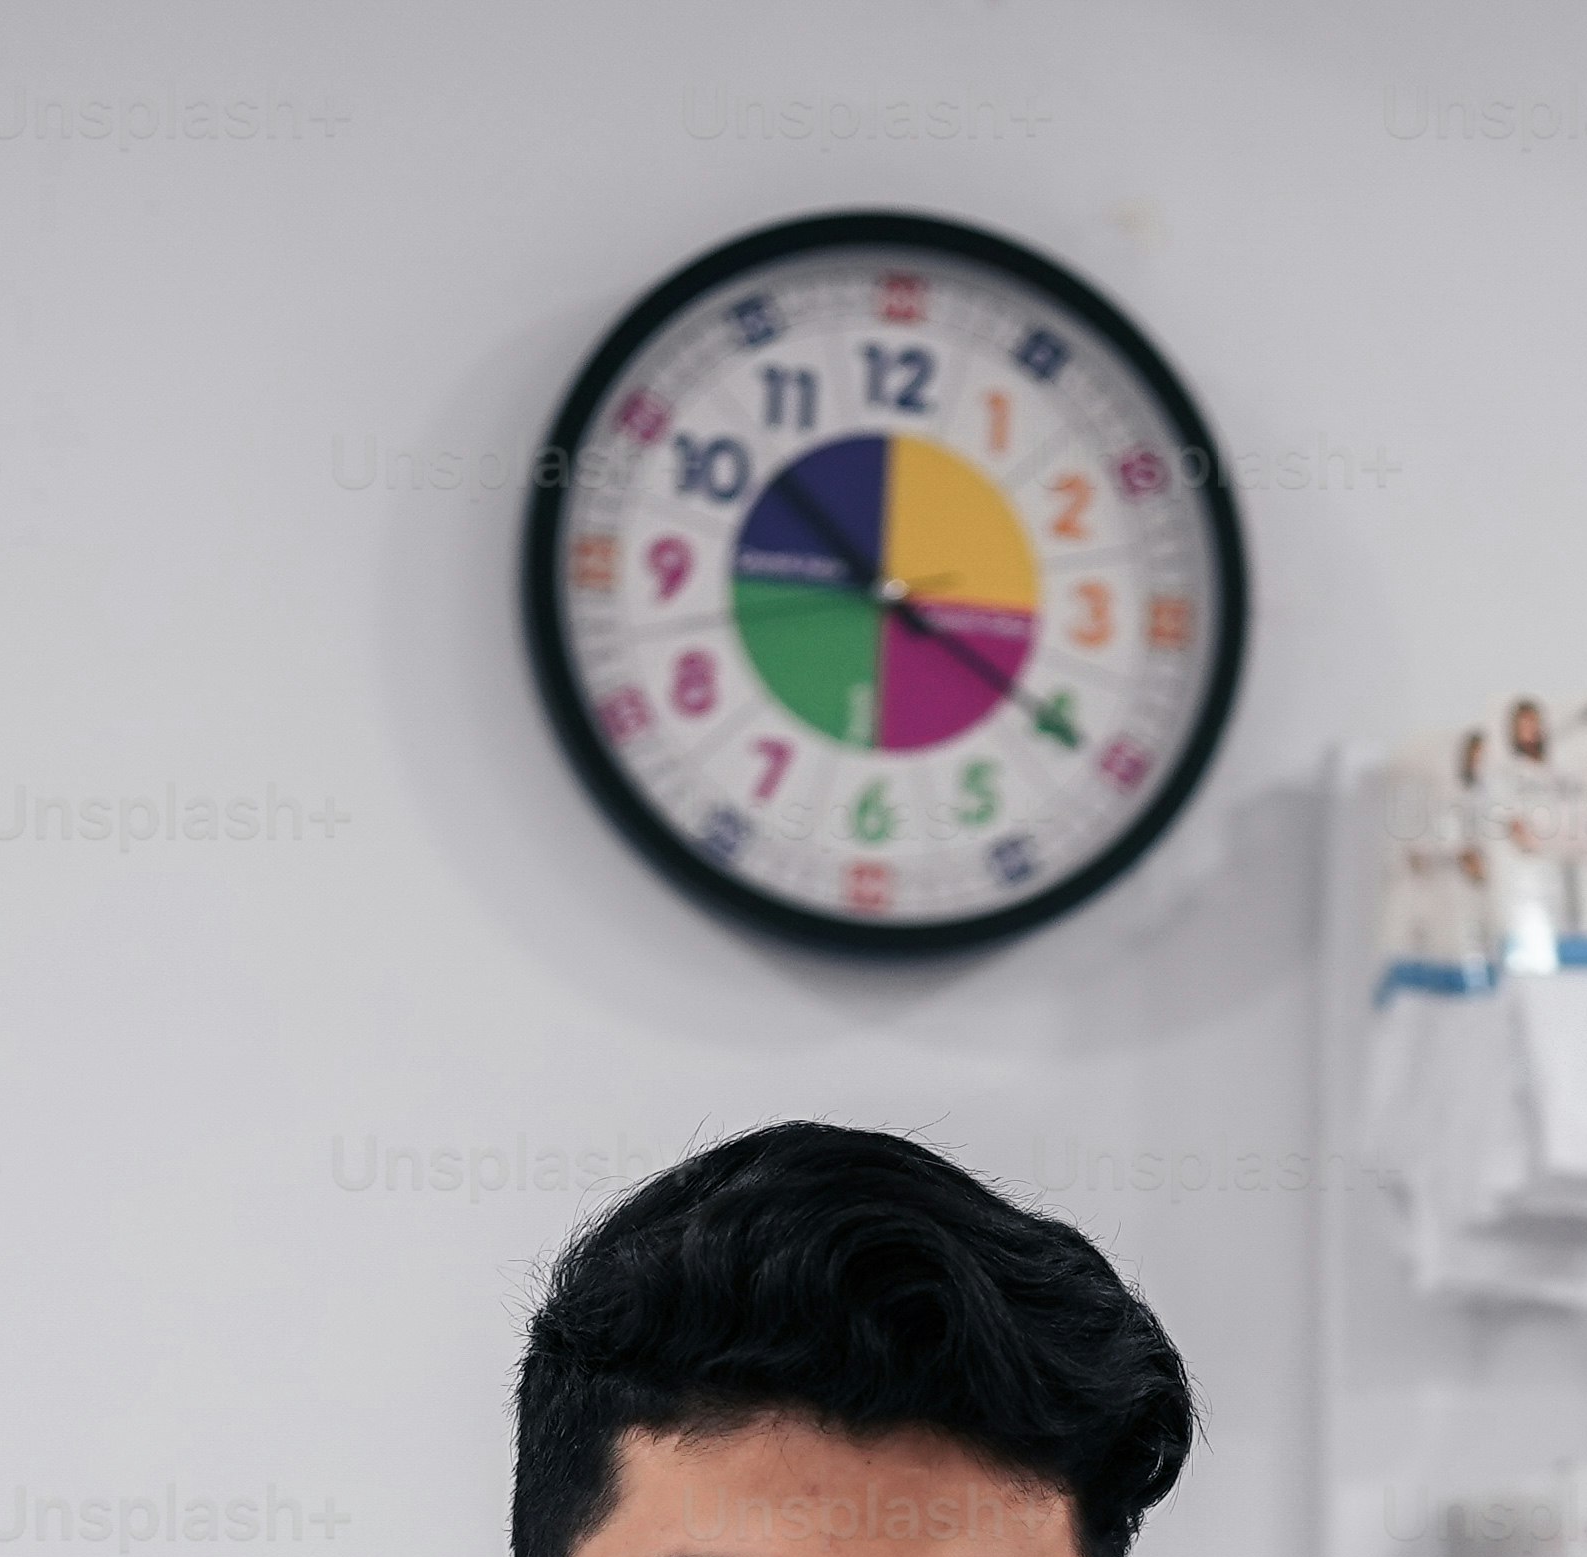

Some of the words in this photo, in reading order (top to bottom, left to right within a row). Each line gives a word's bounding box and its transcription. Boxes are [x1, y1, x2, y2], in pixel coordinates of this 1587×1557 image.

[761, 364, 816, 430] 11
[861, 344, 936, 413] 12
[984, 388, 1010, 453] 1
[674, 434, 750, 503] 10
[1051, 473, 1093, 540] 2
[647, 534, 694, 602] 9
[1072, 580, 1114, 649] 3
[671, 649, 718, 721] 8
[750, 735, 795, 805] 7
[957, 758, 1000, 829] 5
[854, 778, 896, 845] 6
